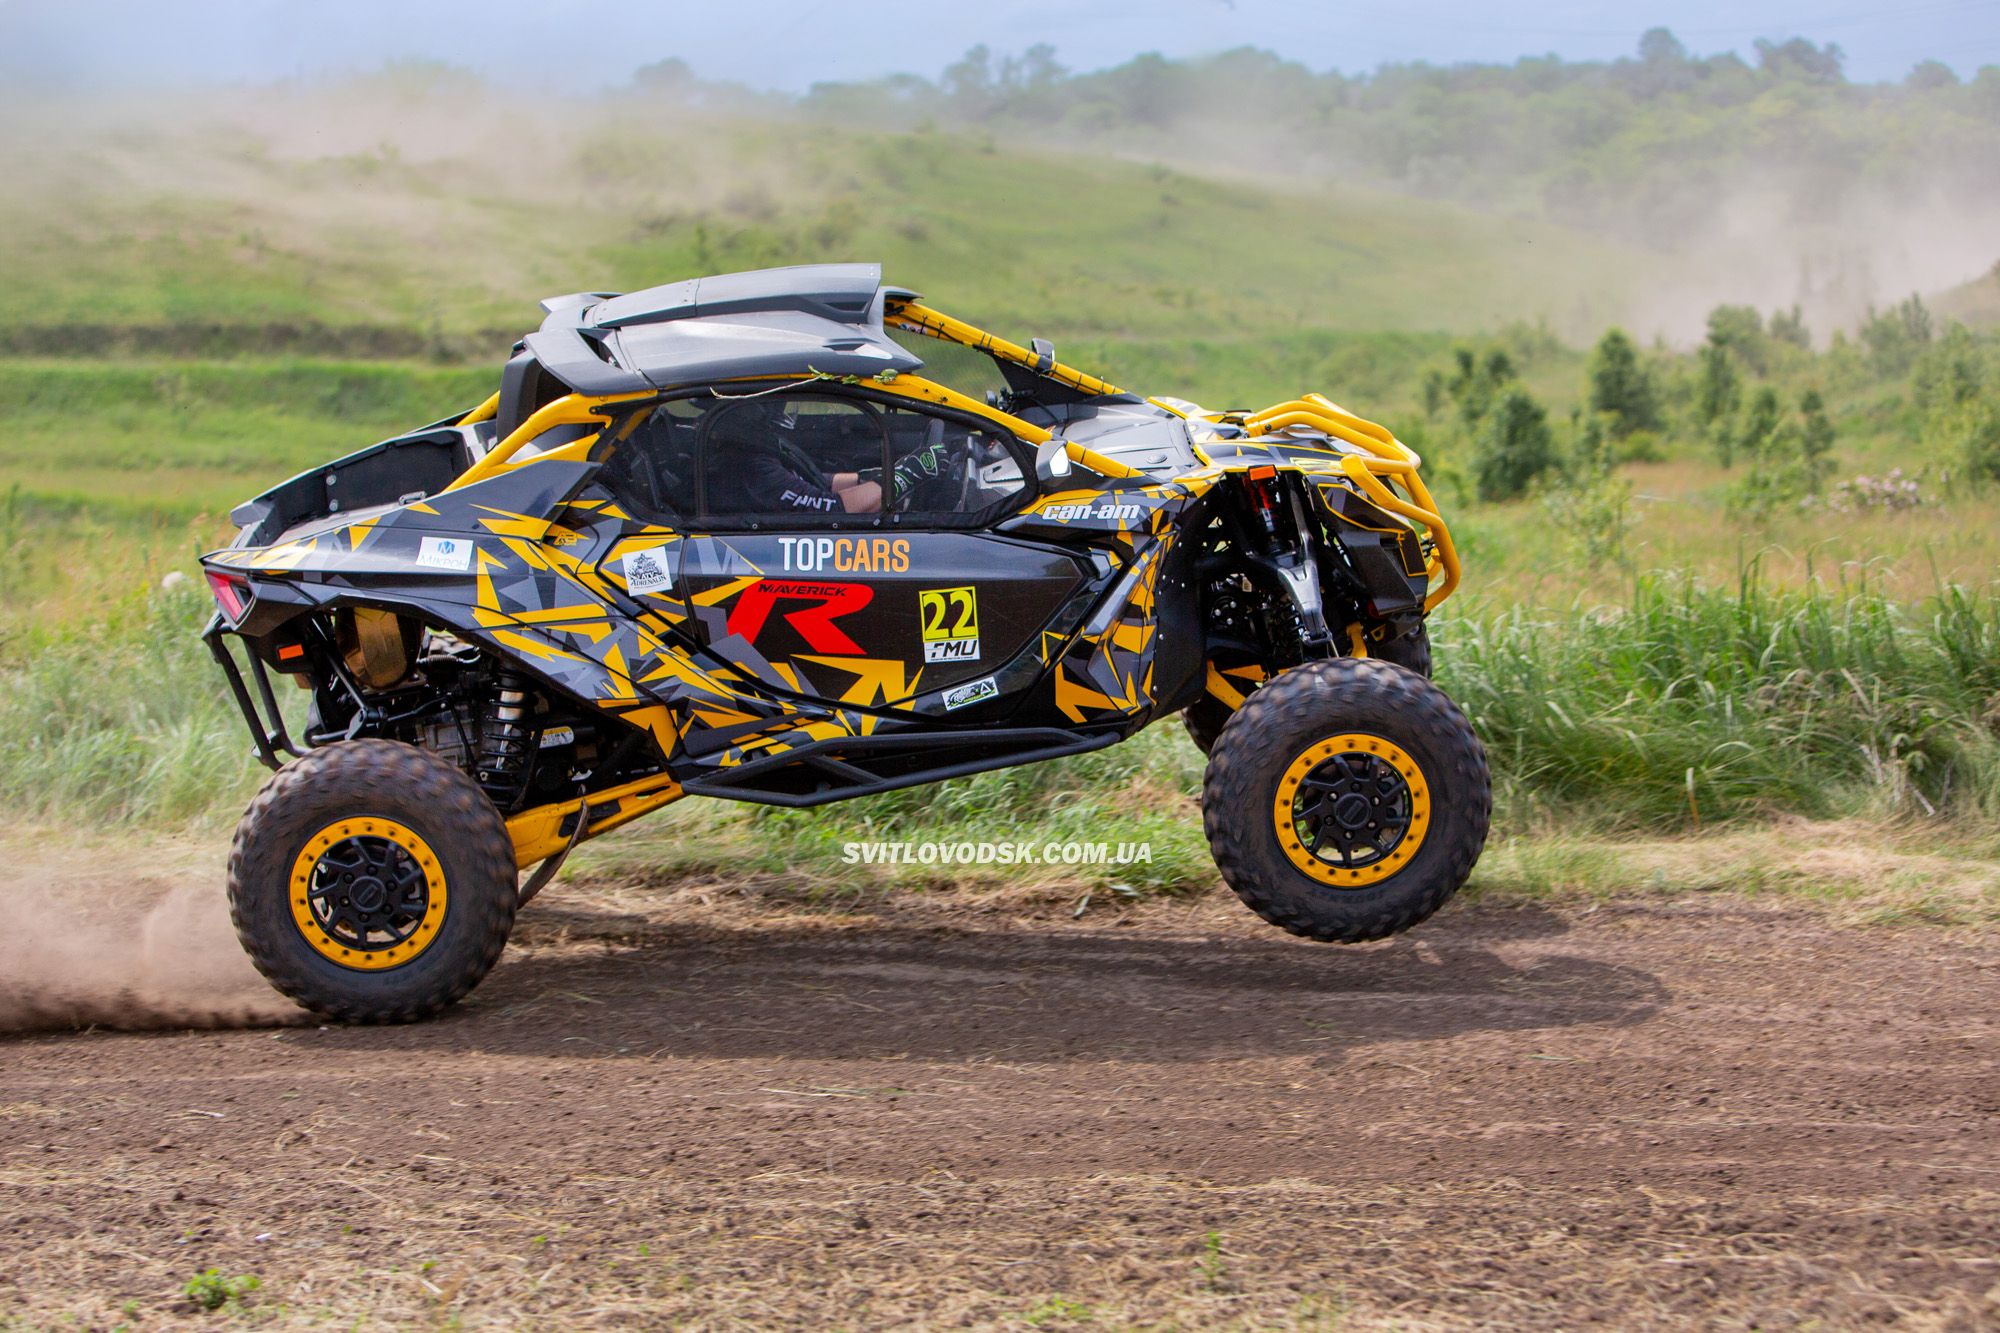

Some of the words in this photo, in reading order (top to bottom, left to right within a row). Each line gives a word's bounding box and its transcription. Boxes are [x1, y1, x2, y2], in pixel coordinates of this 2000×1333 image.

[1042, 504, 1140, 520] can-am
[778, 538, 910, 573] TOPCARS
[758, 583, 849, 597] MAVERICK
[923, 590, 976, 639] 22
[931, 640, 977, 658] FMU
